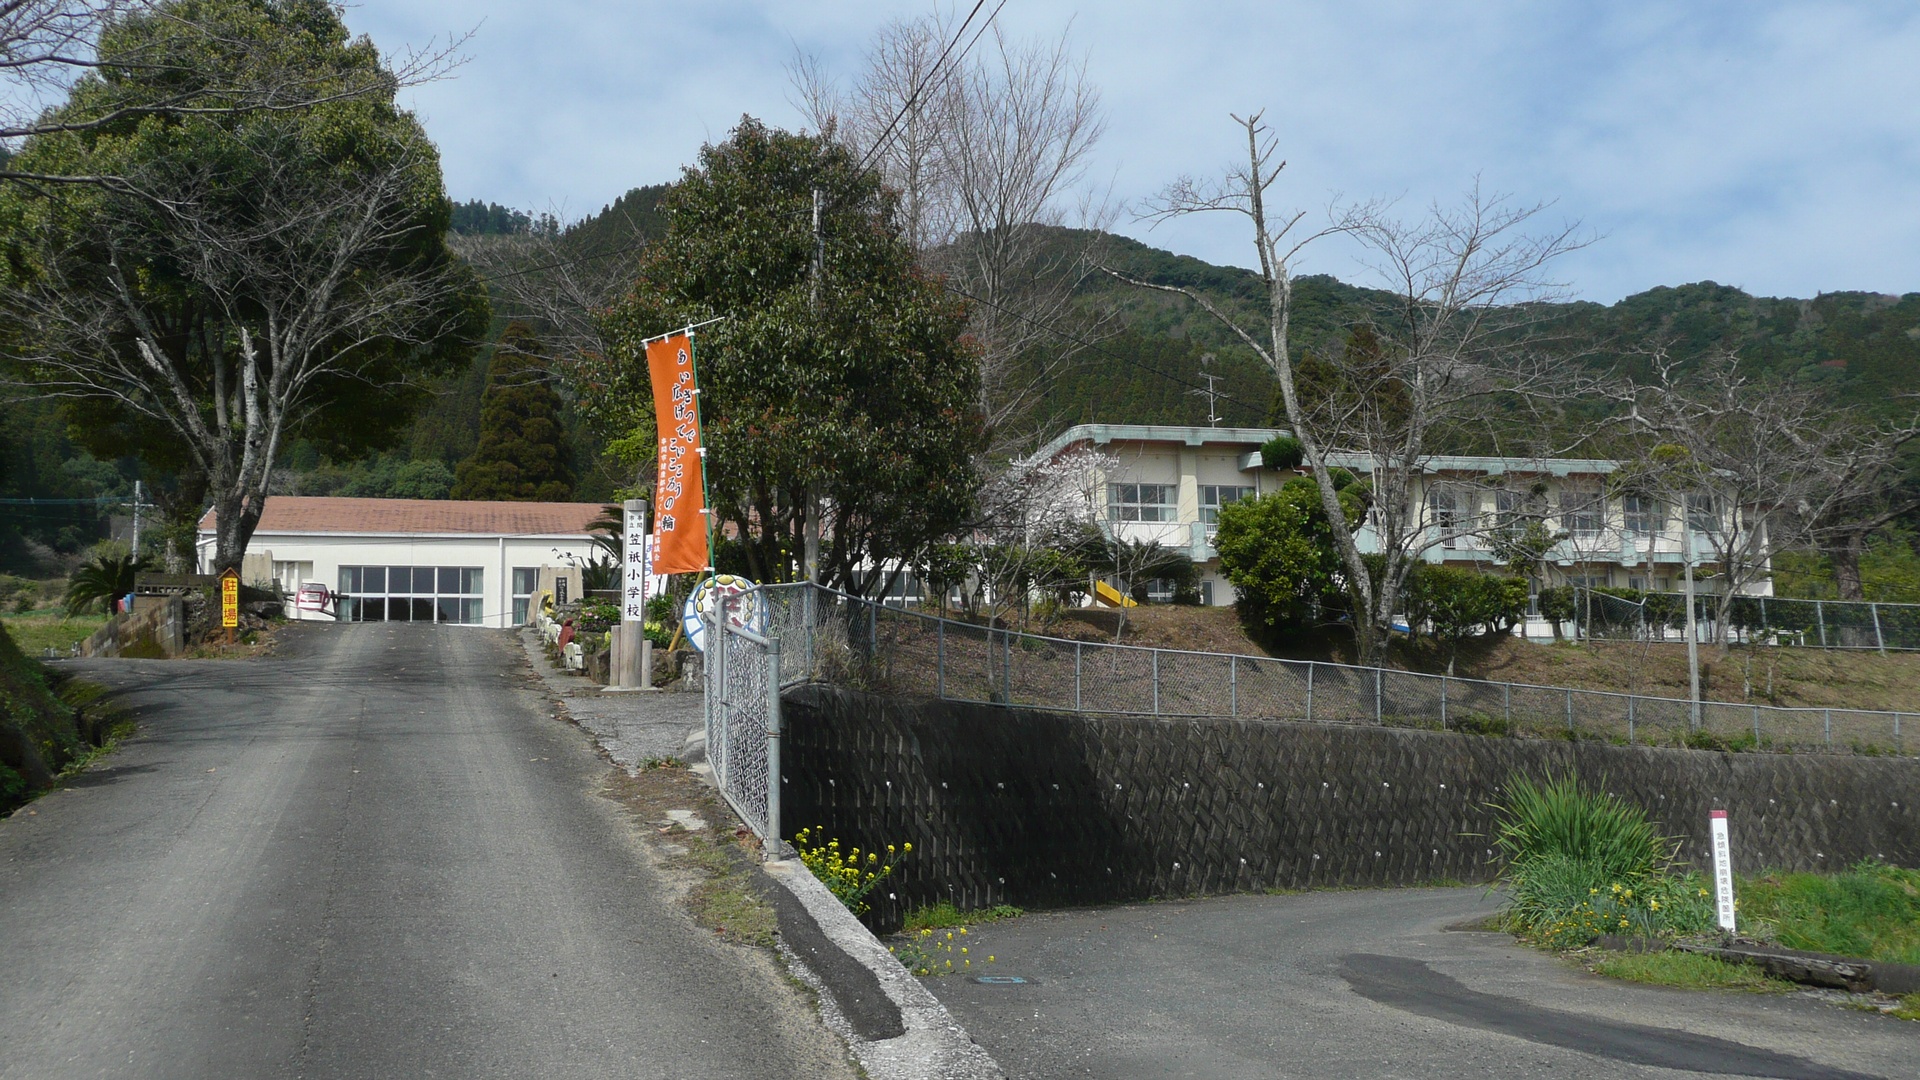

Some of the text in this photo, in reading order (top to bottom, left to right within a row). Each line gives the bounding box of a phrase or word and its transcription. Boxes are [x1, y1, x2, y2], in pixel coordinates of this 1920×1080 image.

[678, 349, 695, 442] あいさつで
[662, 438, 676, 531] こころの輪
[224, 579, 236, 621] 駐車場
